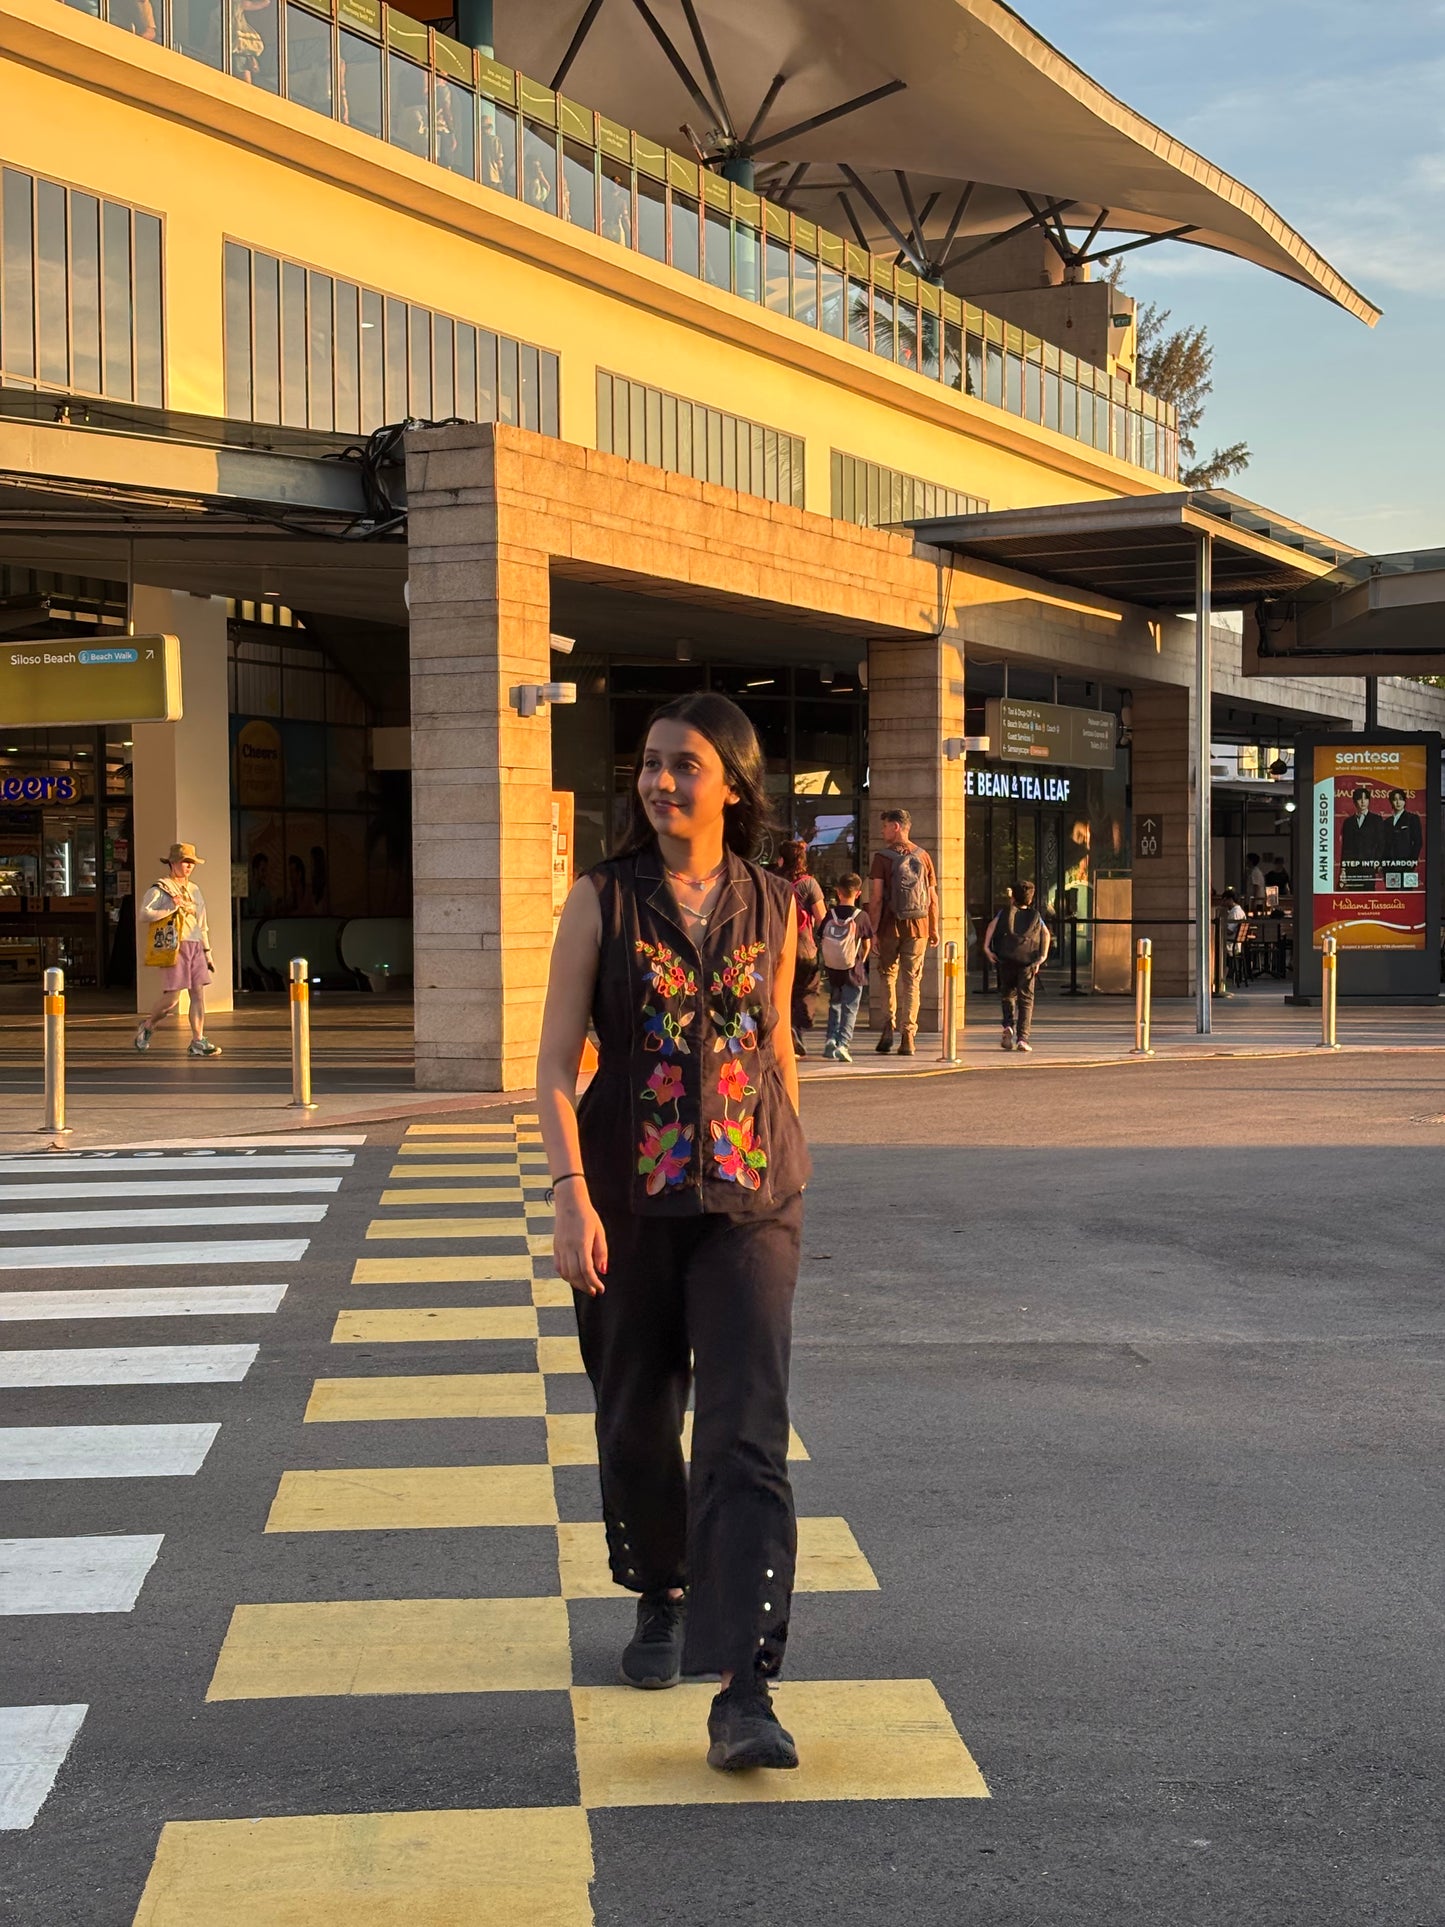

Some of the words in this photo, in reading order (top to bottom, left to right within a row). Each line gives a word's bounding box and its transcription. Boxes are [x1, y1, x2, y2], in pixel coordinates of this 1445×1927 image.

[10, 654, 41, 665] Siloso
[43, 653, 76, 664] Beach
[90, 653, 113, 661] Beach
[114, 651, 133, 660] Walk
[1335, 750, 1400, 764] sentosa
[0, 776, 76, 800] eers
[964, 770, 974, 796] E
[977, 772, 1009, 798] BEAN
[1020, 776, 1042, 800] TEA
[1044, 778, 1070, 802] LEAF
[1319, 793, 1328, 824] SEOP
[1319, 828, 1328, 853] HYO
[1319, 856, 1328, 881] AHN
[1342, 860, 1361, 868] STEP
[1361, 860, 1380, 868] INTO
[1332, 898, 1370, 910] Madame
[1368, 898, 1406, 910] Tussauds
